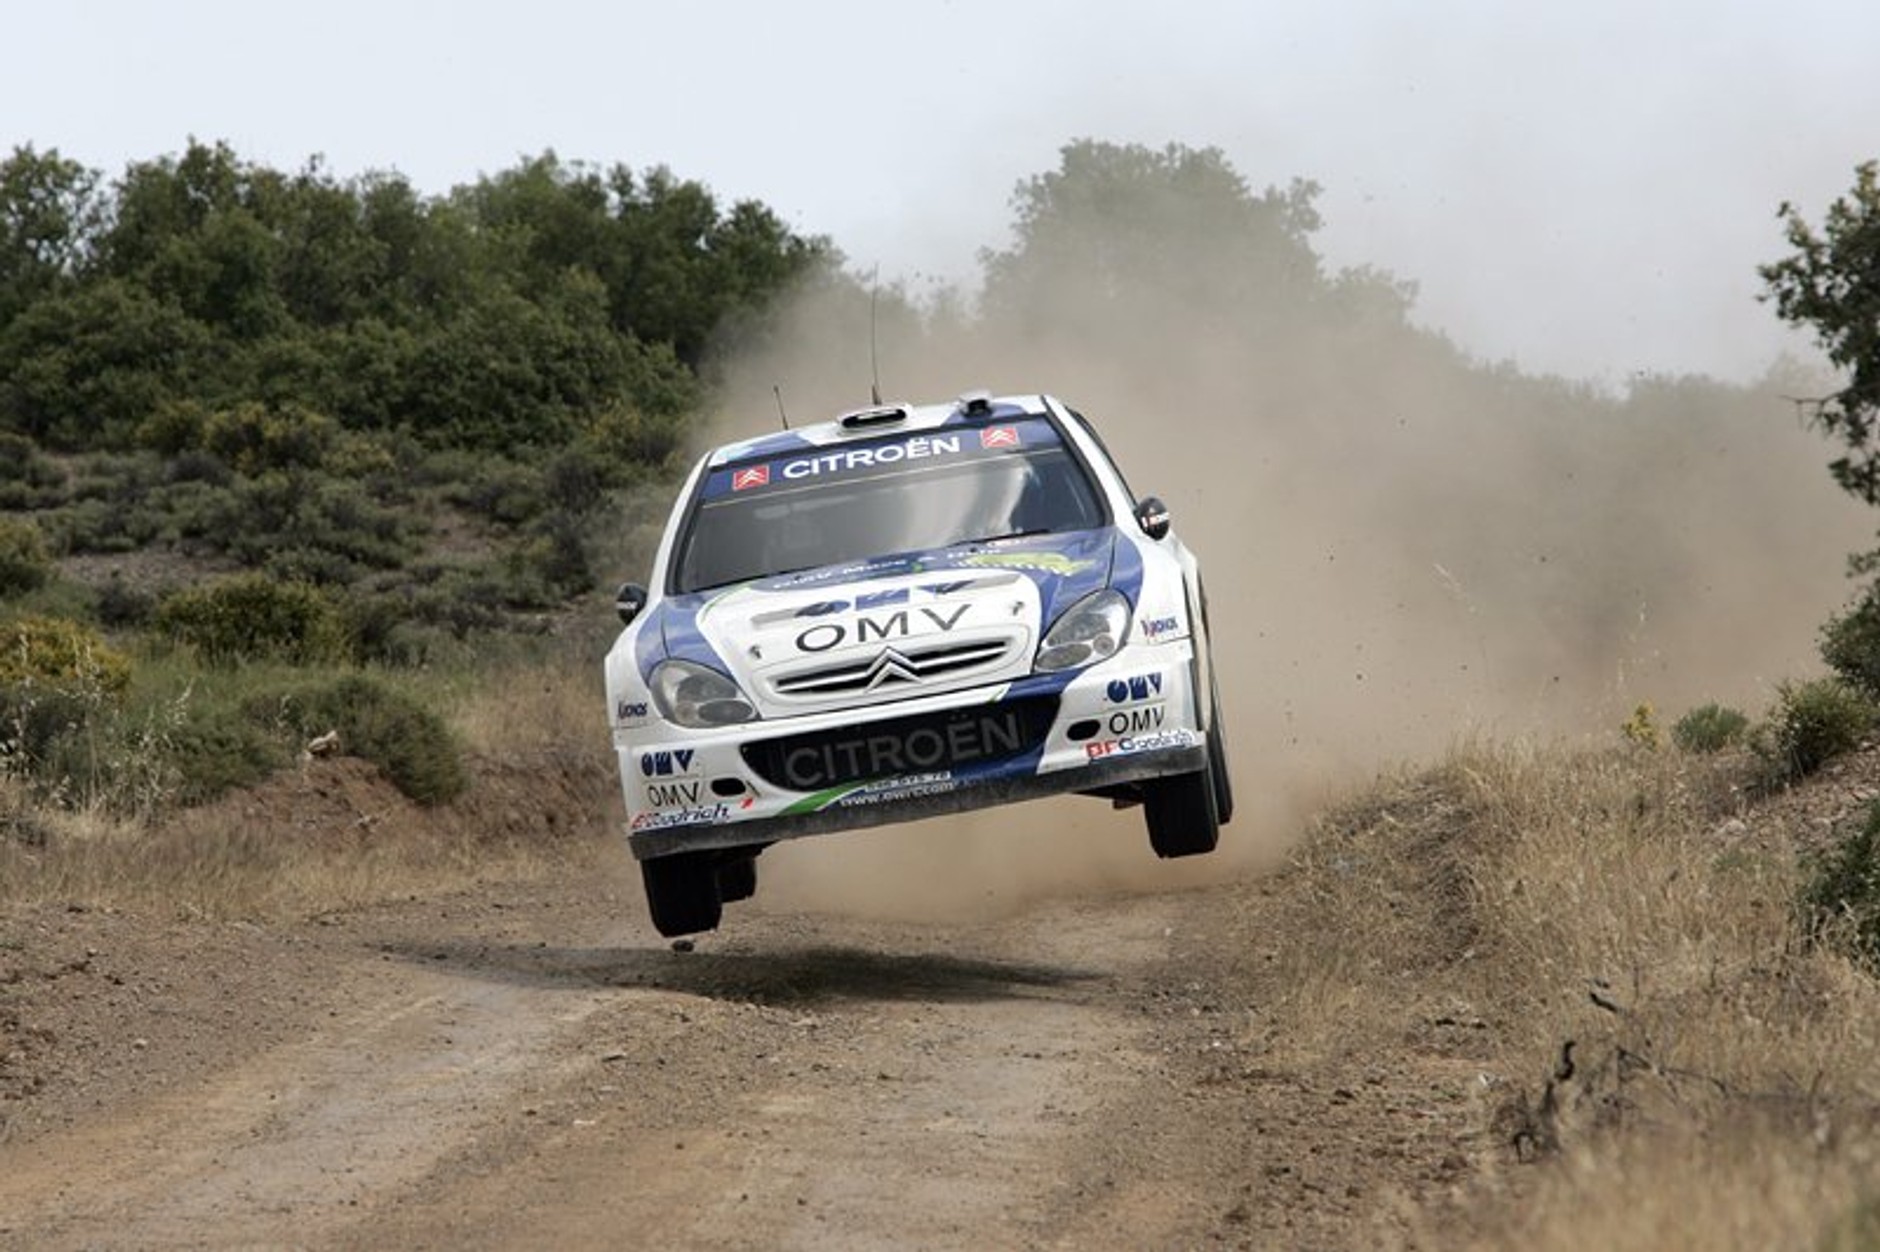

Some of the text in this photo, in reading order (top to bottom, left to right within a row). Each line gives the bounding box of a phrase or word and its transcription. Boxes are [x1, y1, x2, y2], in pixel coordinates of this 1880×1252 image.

[783, 436, 960, 479] CITROËN
[796, 603, 971, 651] OMV
[1109, 706, 1165, 735] OMV
[785, 712, 1020, 787] CITROËN
[648, 782, 698, 807] OMV
